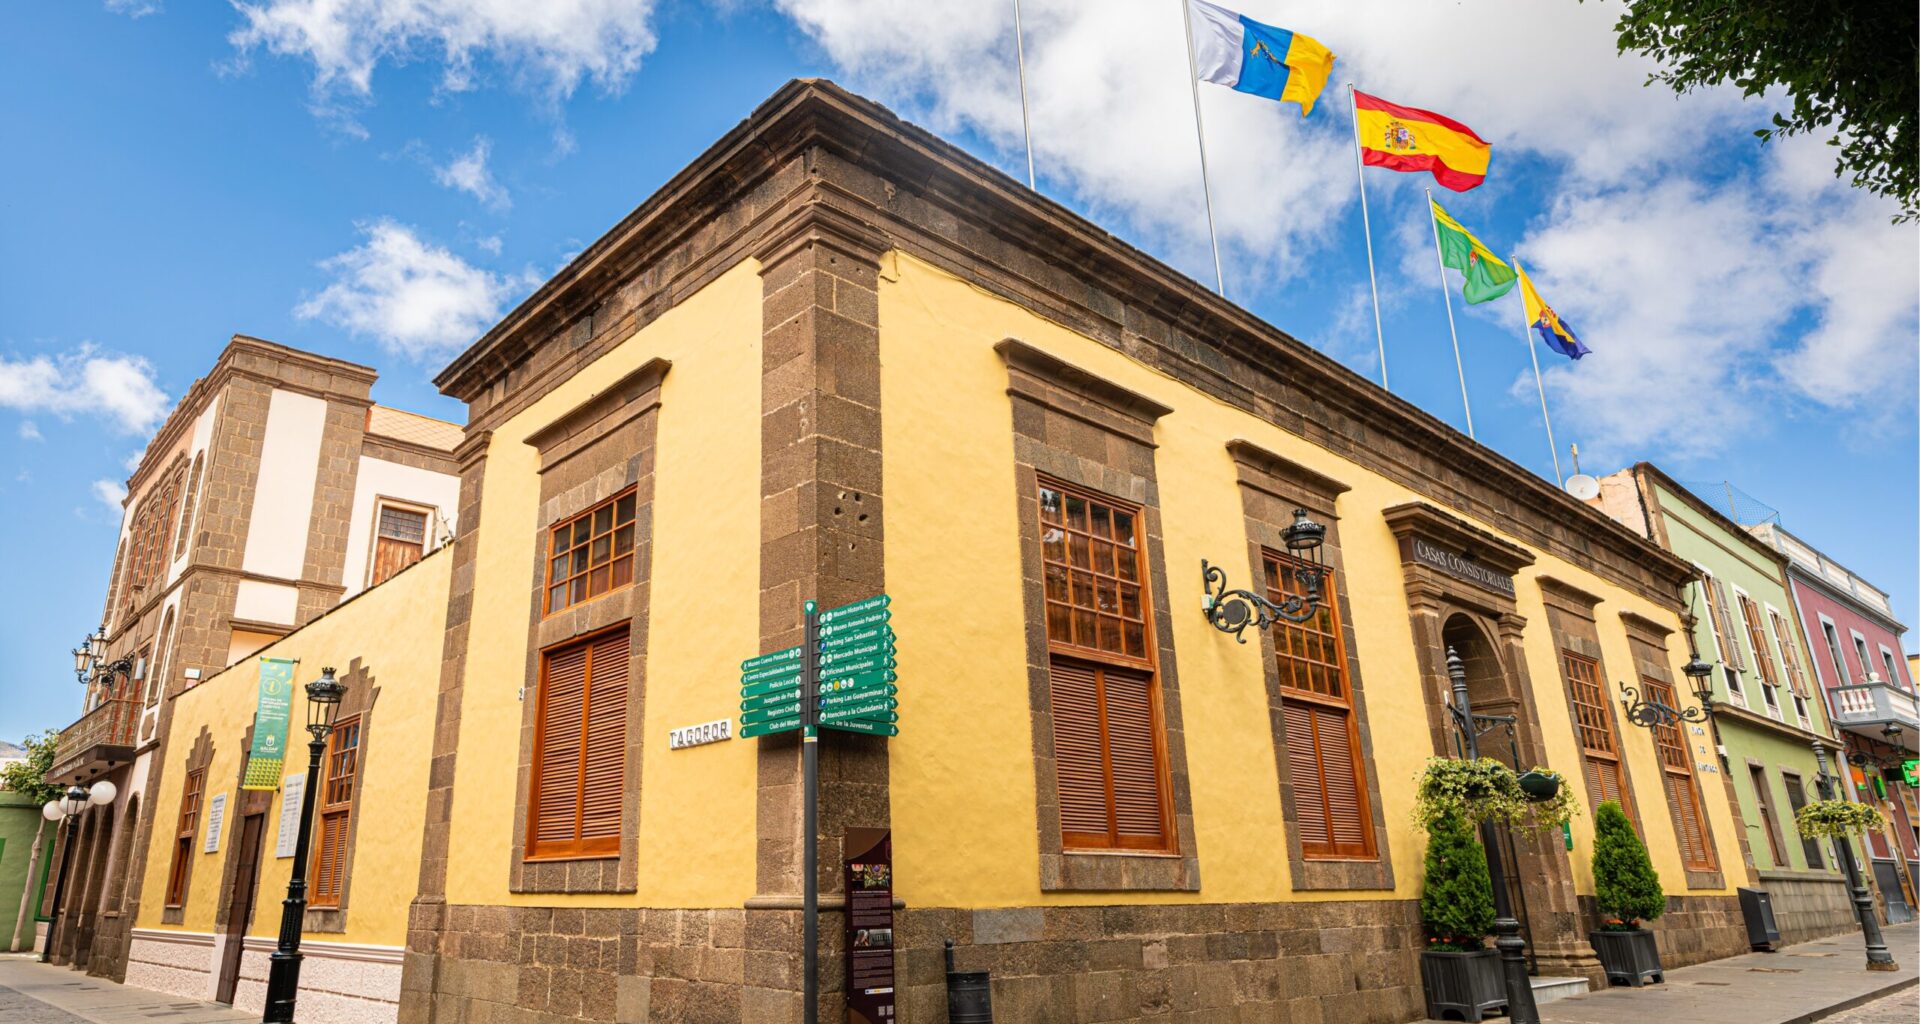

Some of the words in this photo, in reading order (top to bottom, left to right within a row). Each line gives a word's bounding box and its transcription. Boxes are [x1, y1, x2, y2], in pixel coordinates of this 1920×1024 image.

[1417, 539, 1446, 567] CASAS
[1448, 552, 1514, 592] CONSISTORIALES
[848, 605, 864, 613] Historia
[848, 618, 865, 628] Antonio
[826, 639, 844, 648] Parking
[834, 651, 854, 659] Mercado
[854, 643, 878, 654] Municipal
[846, 660, 874, 670] Municipales
[853, 689, 883, 700] Guayarminas
[768, 708, 784, 717] Registro
[826, 710, 847, 718] Atención
[856, 704, 883, 713] Ciudadanía
[670, 721, 728, 748] TAGOROR
